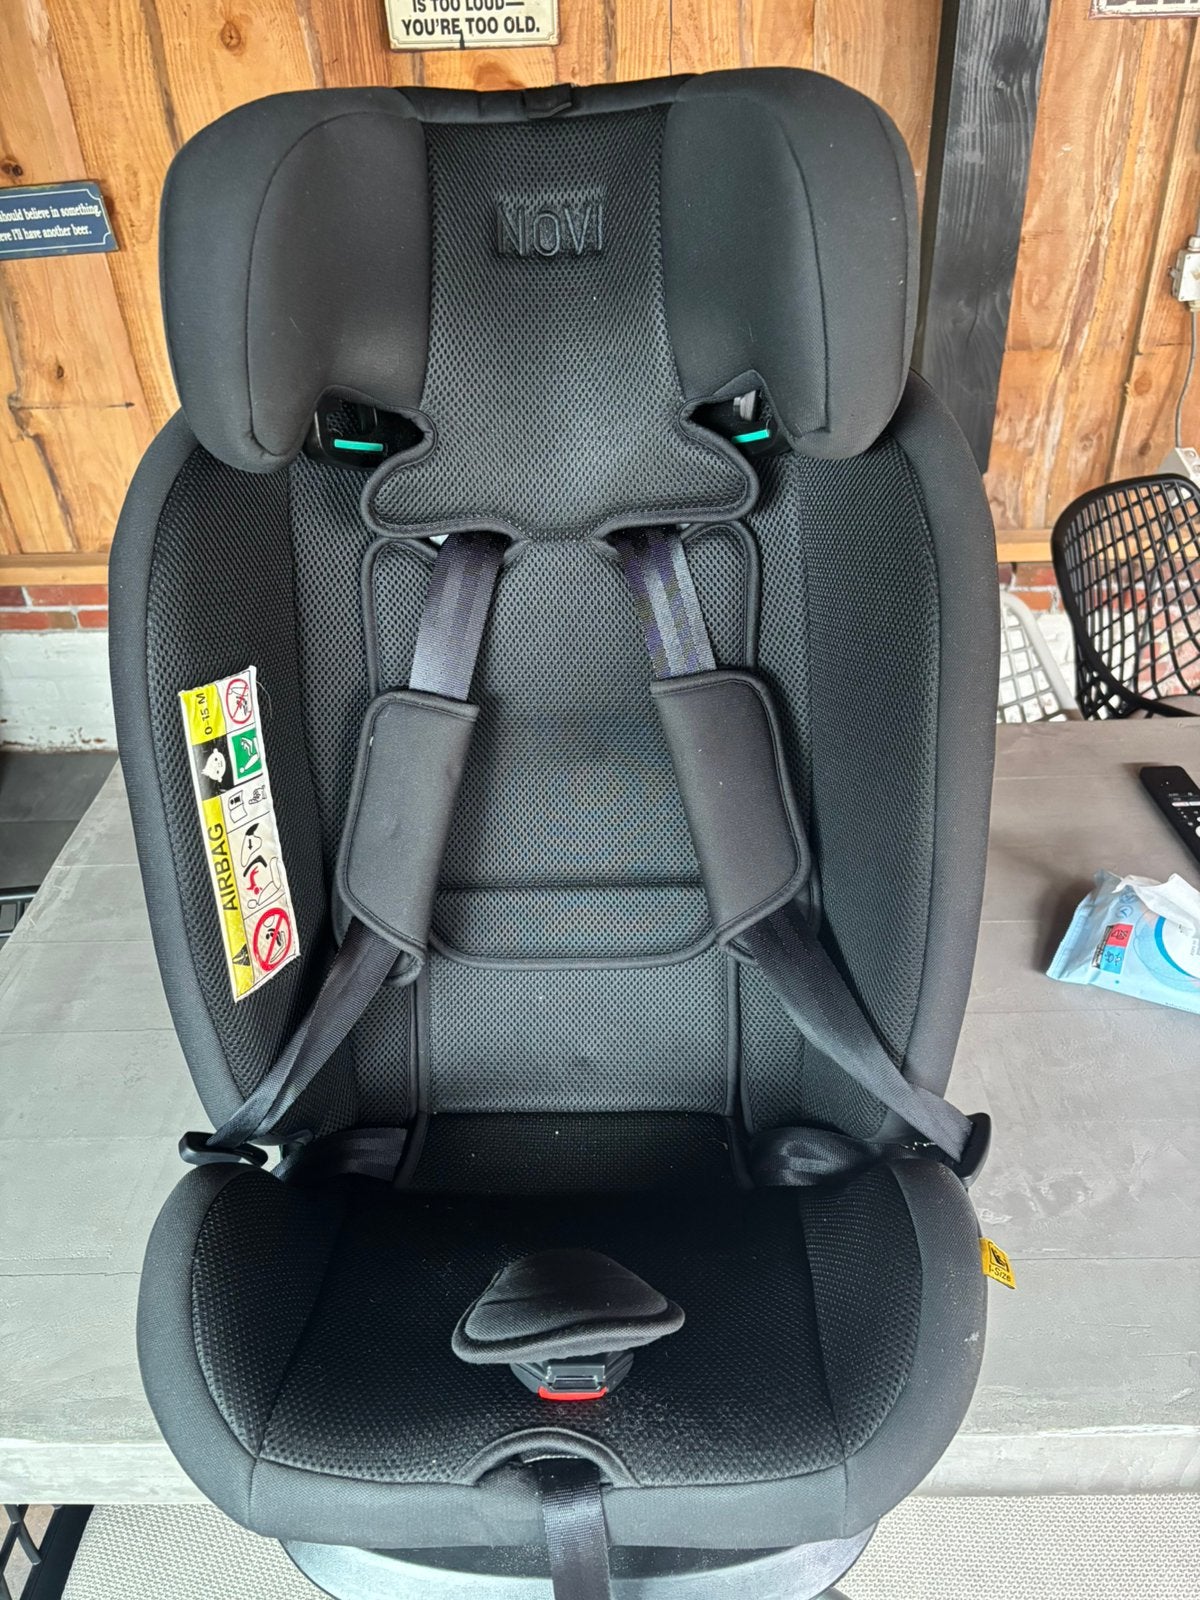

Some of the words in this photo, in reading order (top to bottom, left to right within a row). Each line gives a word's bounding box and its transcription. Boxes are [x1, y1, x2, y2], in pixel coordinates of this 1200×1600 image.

[413, 0, 426, 12] IS
[433, 0, 461, 12] TOO
[401, 18, 461, 36] YOU'RE
[465, 17, 498, 34] TOO
[503, 16, 540, 33] OLD.
[23, 207, 50, 220] believe
[50, 205, 60, 218] in
[11, 228, 24, 240] I'll
[22, 228, 42, 240] have
[42, 225, 71, 238] another
[71, 224, 92, 236] beer.
[497, 201, 602, 256] NOVI
[195, 692, 206, 705] M
[200, 708, 213, 735] 0-15
[208, 823, 239, 911] AIRBAG
